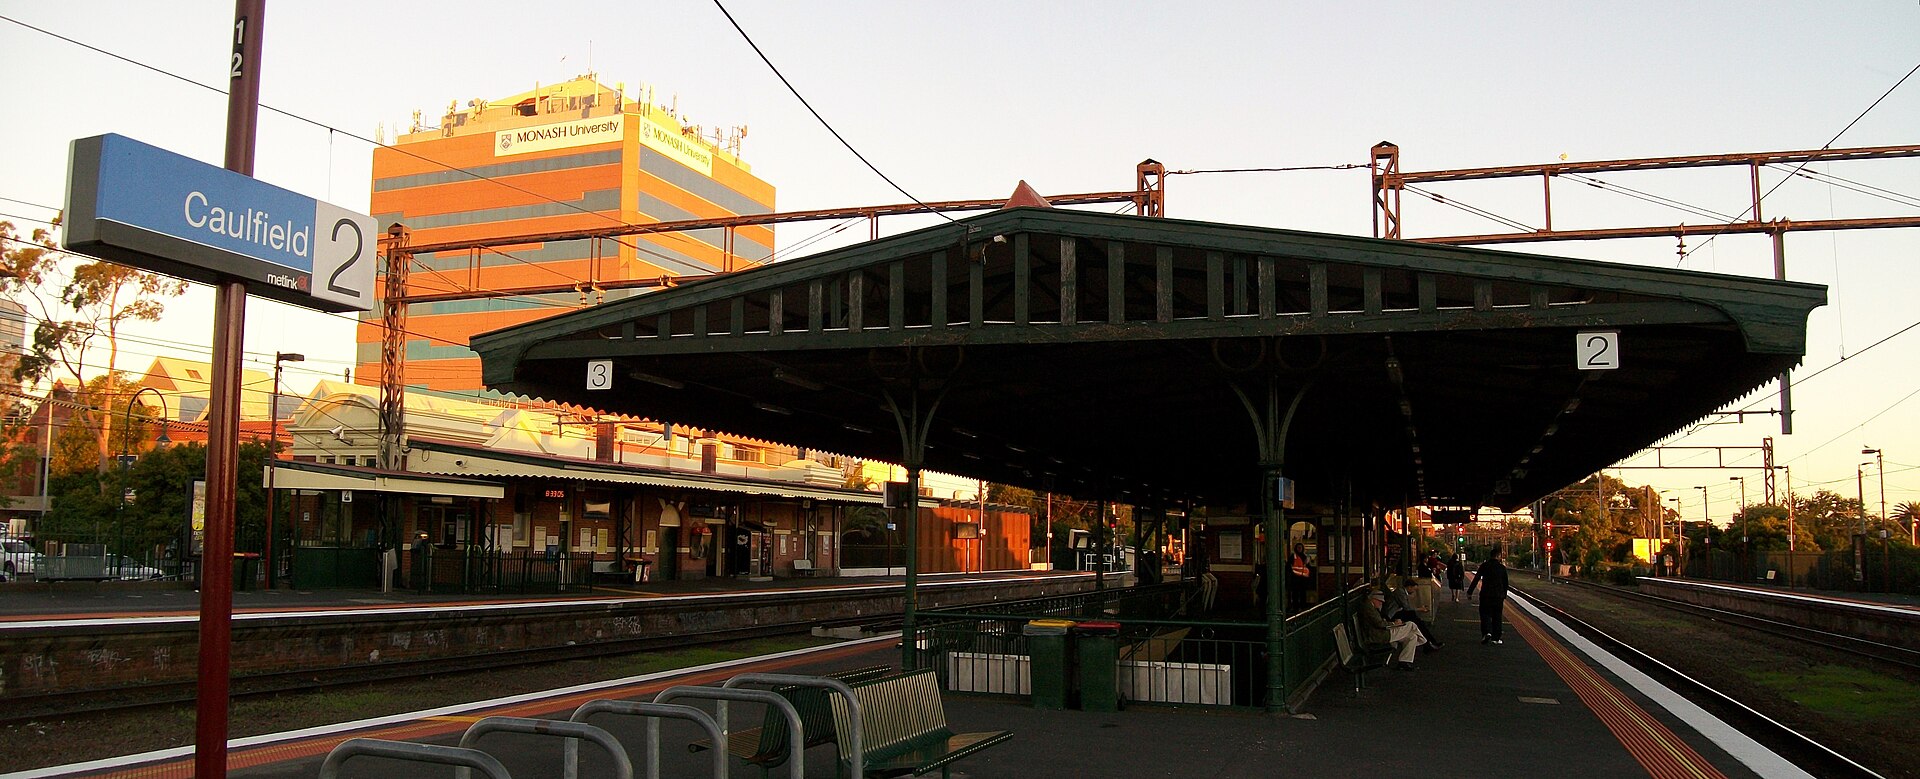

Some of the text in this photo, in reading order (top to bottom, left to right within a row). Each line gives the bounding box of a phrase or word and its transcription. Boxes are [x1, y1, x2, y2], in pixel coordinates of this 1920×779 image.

[516, 120, 619, 144] MONASH University
[653, 127, 711, 168] MONASH University
[184, 191, 309, 257] Caulfield
[327, 217, 364, 298] 2
[267, 273, 298, 290] metlink
[1587, 336, 1609, 366] 2
[592, 364, 606, 387] 3
[344, 490, 351, 501] 4
